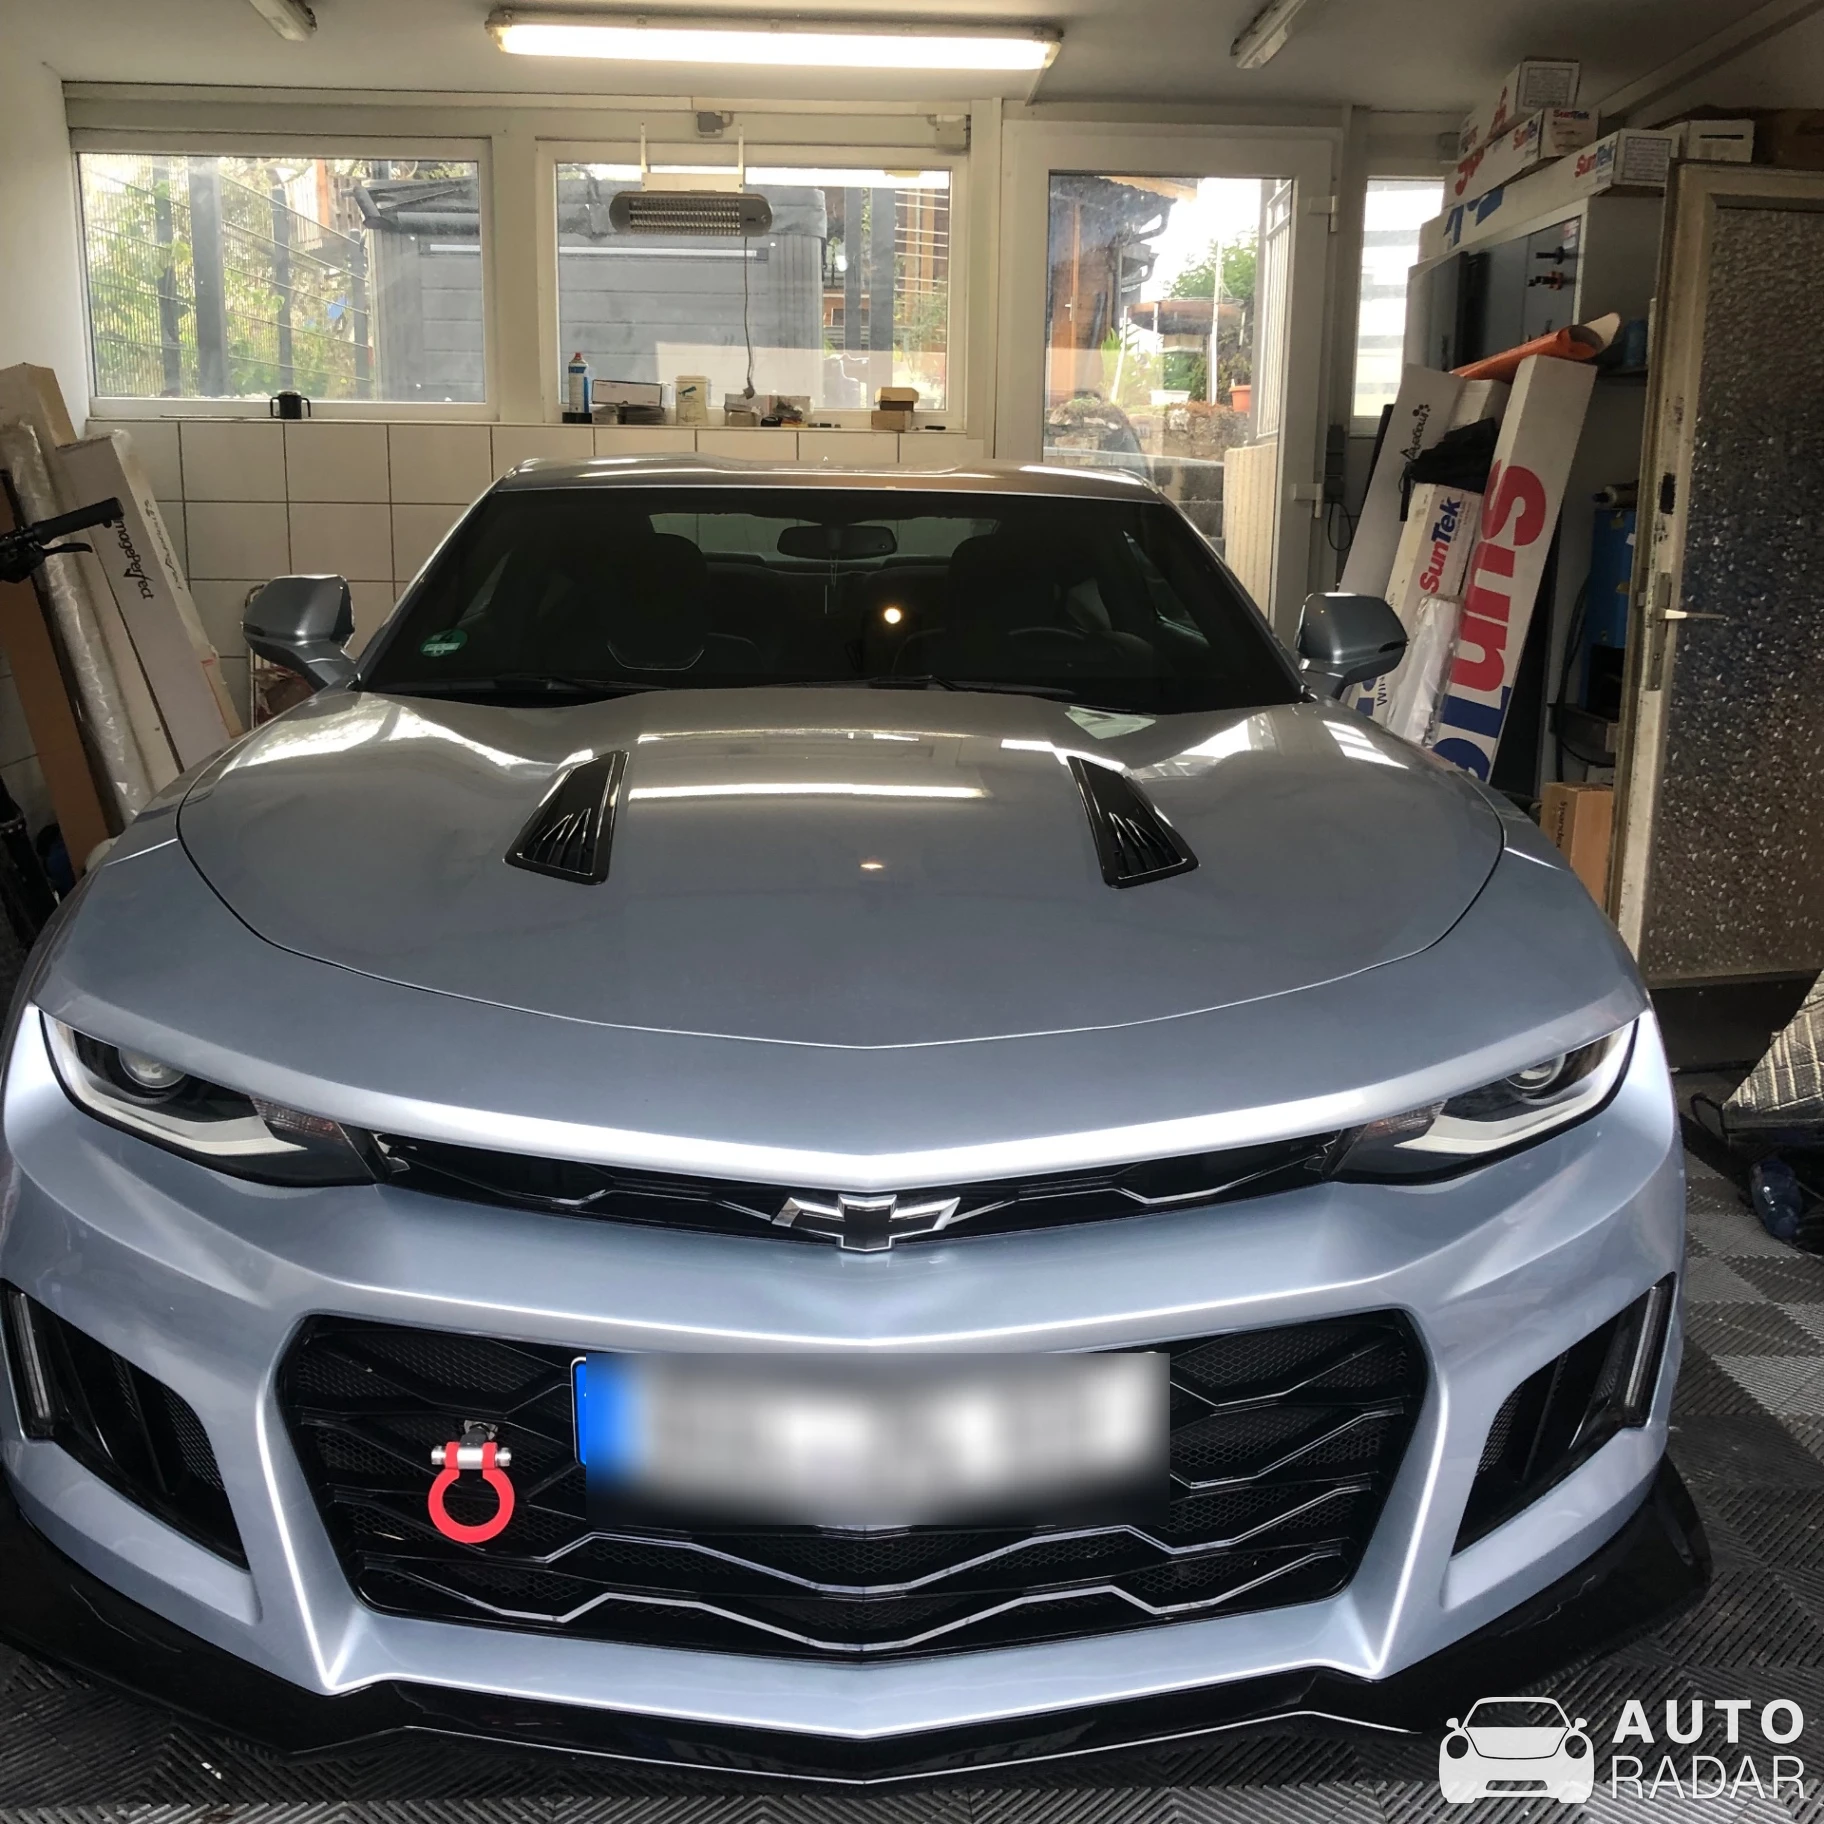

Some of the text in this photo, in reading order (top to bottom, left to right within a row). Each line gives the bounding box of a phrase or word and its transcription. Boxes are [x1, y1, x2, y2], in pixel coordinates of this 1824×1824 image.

[1553, 109, 1589, 120] SunTek
[115, 520, 154, 599] magePerfect
[1420, 496, 1460, 594] SunTek
